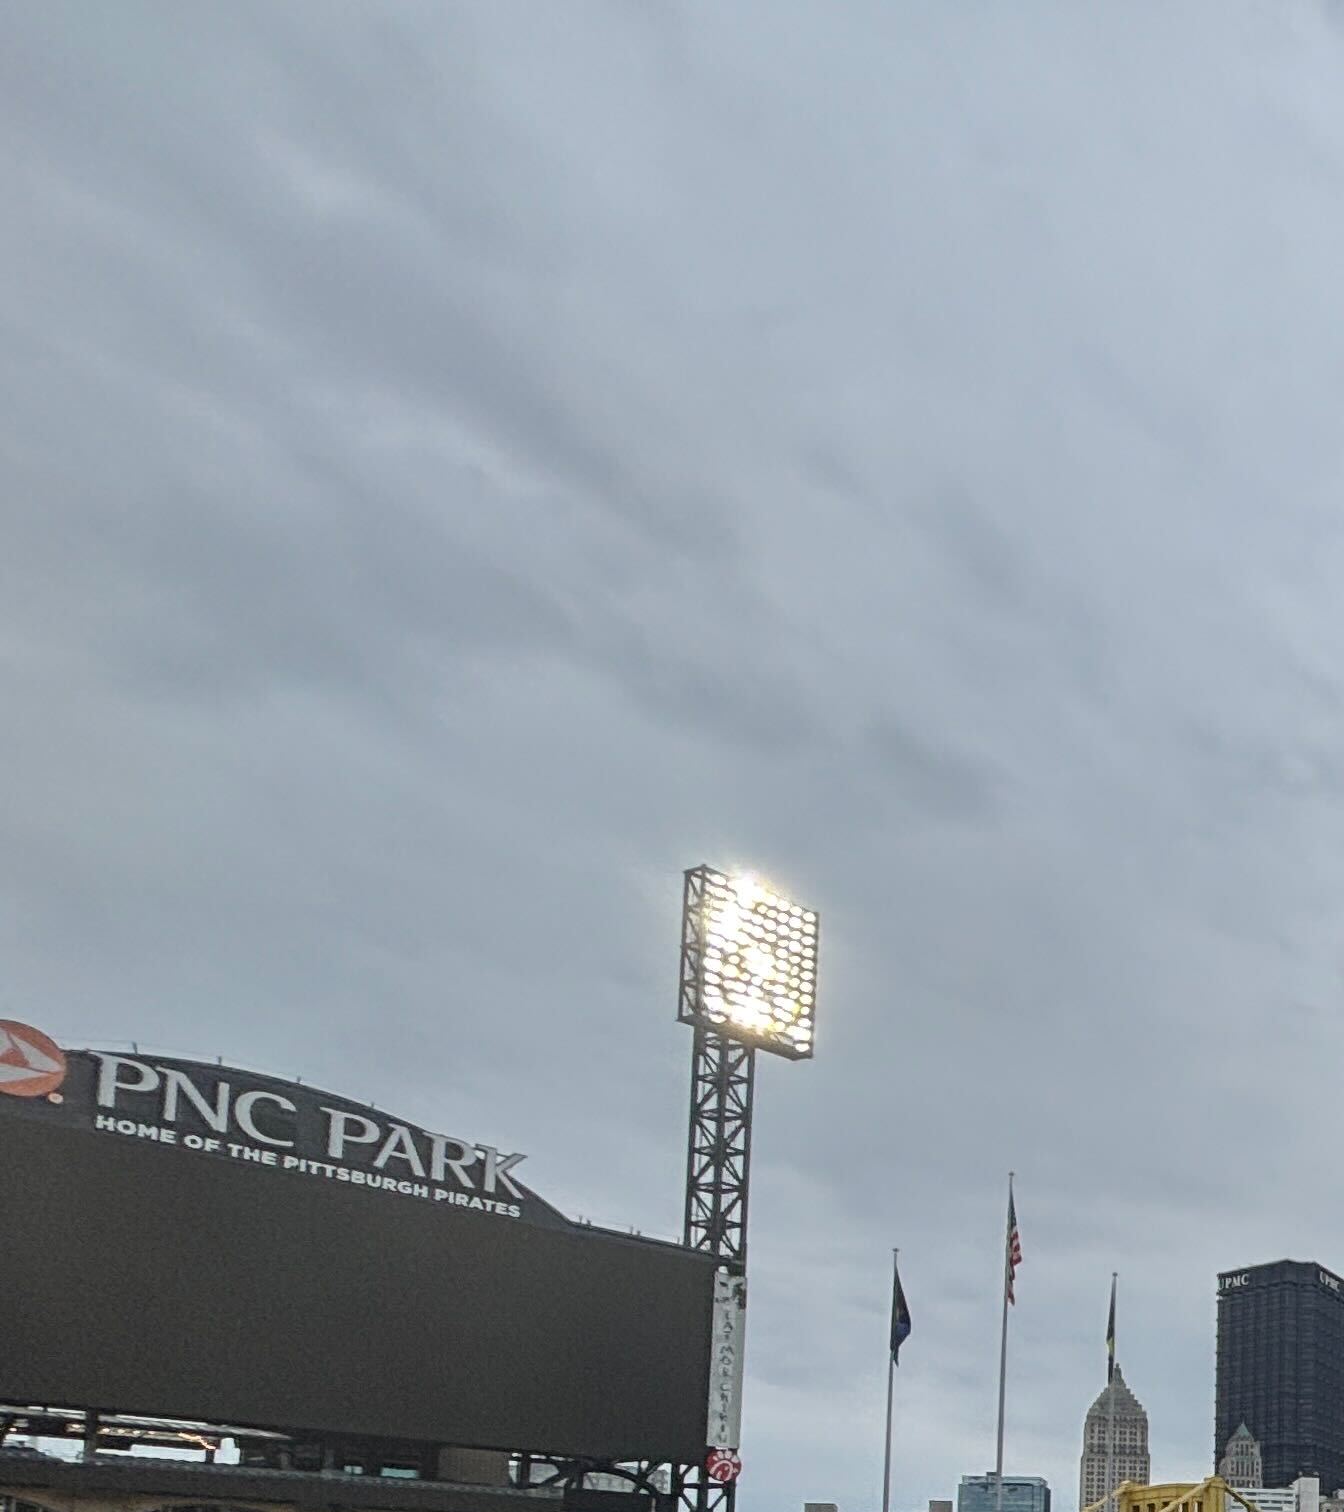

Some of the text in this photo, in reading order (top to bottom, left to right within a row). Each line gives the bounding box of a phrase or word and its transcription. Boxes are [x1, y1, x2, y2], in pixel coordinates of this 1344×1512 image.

[88, 1050, 528, 1199] PNC PARK
[96, 1114, 521, 1218] HOME OF THE PITTSBURGH PIRATES
[1218, 1274, 1249, 1291] UPMC
